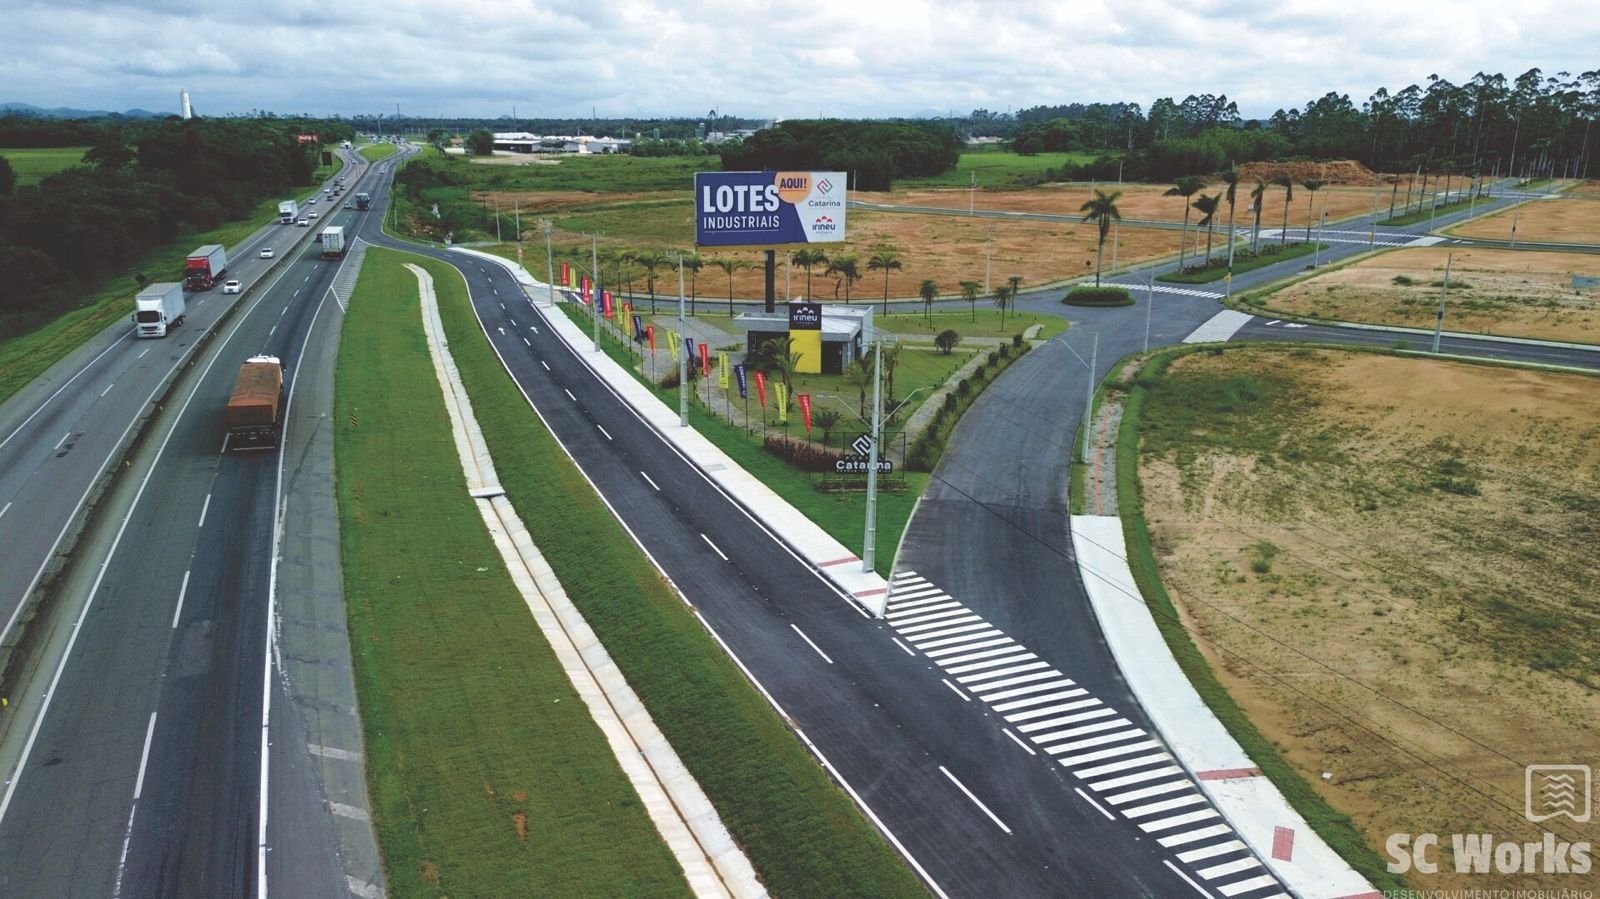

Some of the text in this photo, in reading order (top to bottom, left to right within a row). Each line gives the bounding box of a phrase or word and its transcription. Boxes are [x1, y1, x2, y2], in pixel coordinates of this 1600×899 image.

[780, 178, 807, 188] AQUI!
[703, 185, 780, 213] LOTES
[703, 215, 780, 229] INDUSTRIAIS
[836, 460, 891, 470] Catarna
